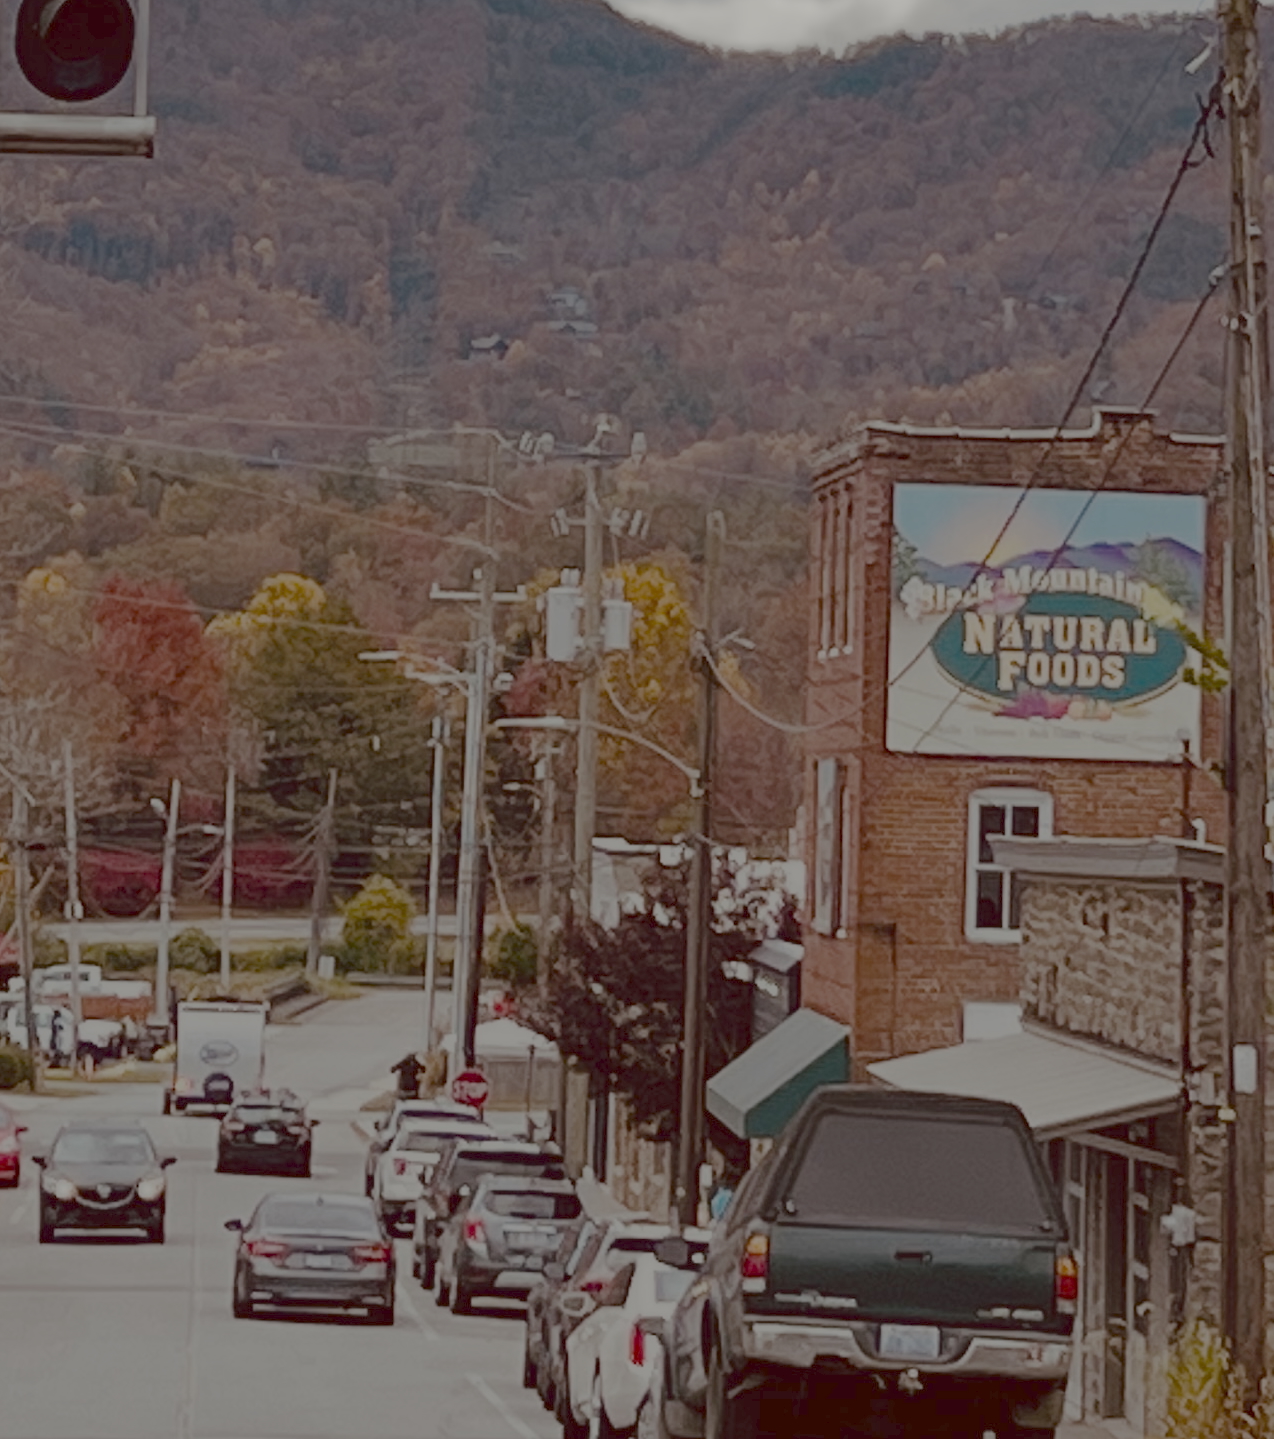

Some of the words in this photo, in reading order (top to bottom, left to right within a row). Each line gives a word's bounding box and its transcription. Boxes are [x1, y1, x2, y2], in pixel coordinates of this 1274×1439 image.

[919, 571, 995, 611] Black
[1002, 564, 1146, 605] Mountain
[962, 611, 1158, 655] NATURAL
[996, 650, 1127, 691] FOODS
